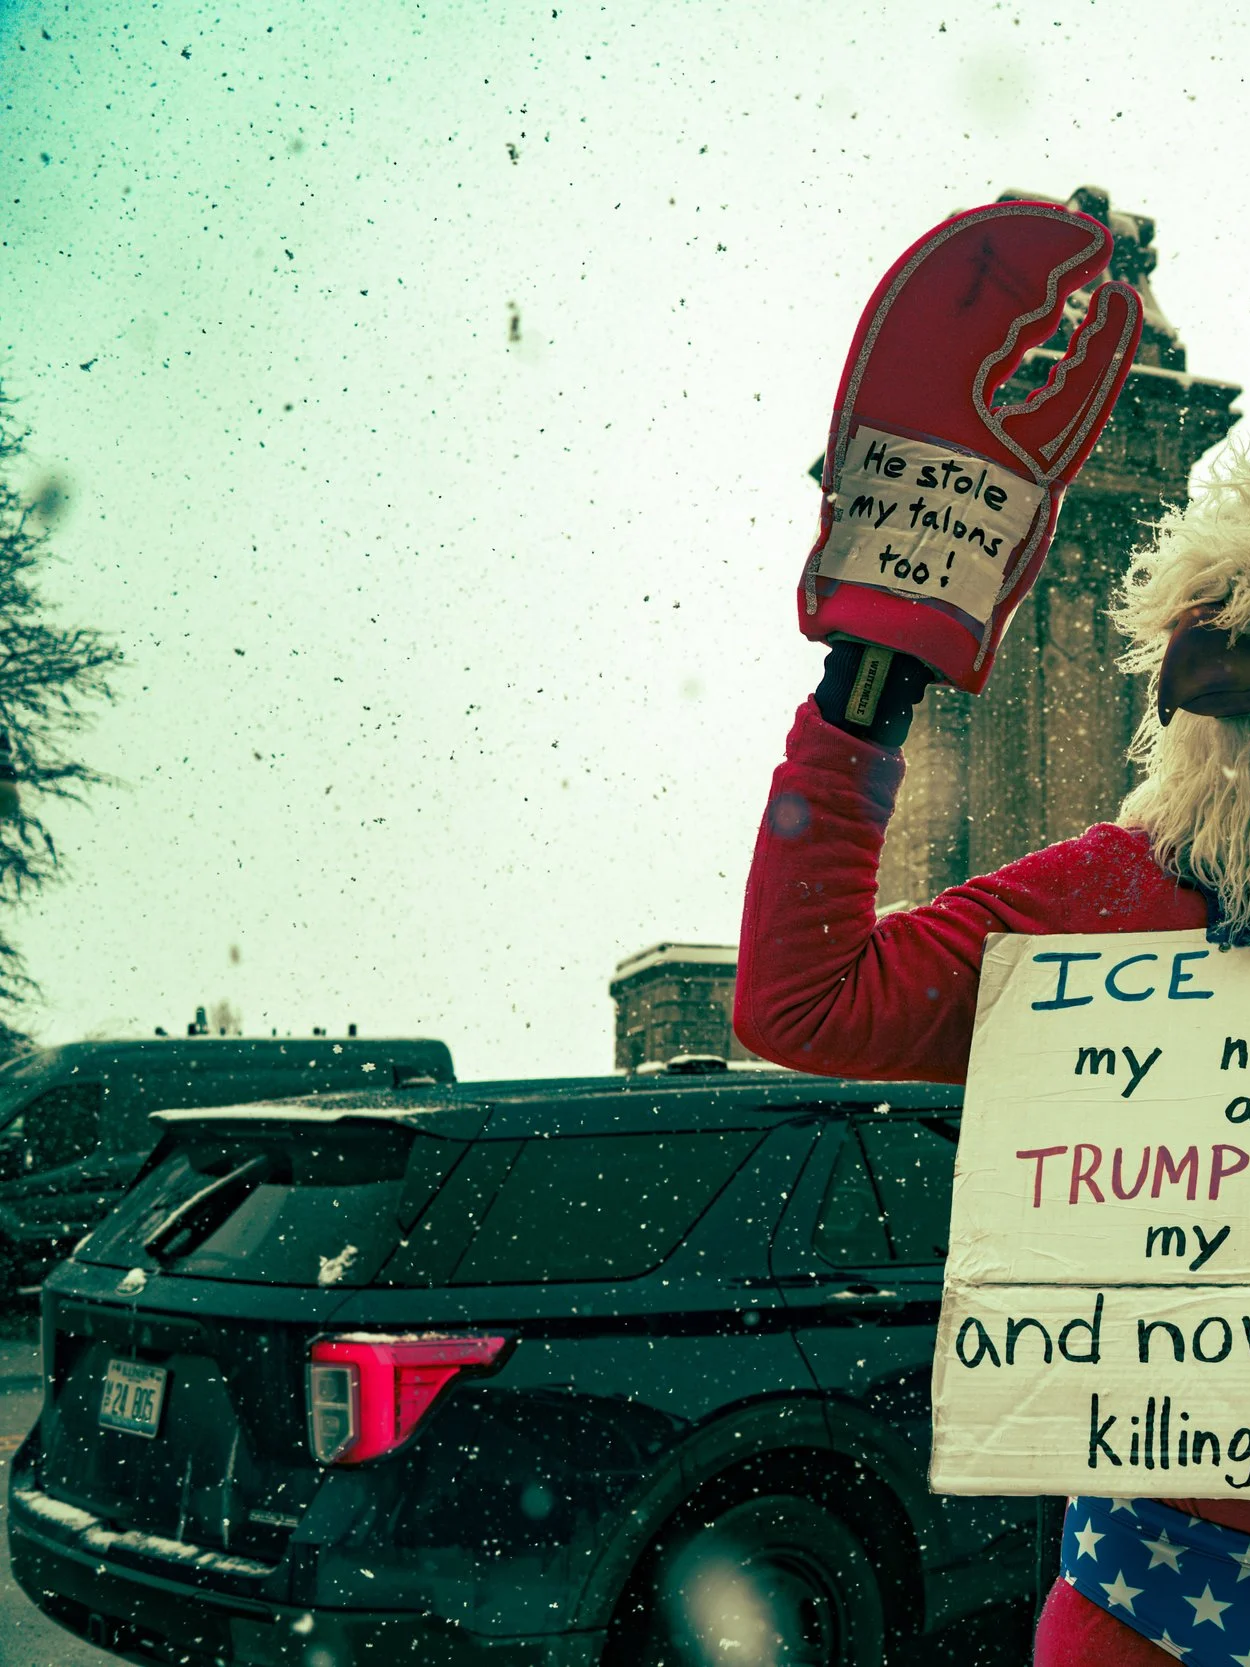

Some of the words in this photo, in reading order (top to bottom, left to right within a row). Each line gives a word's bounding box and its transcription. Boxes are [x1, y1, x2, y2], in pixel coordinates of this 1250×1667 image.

[864, 441, 907, 478] He
[916, 460, 1008, 512] stole
[849, 495, 898, 530] my
[909, 497, 1003, 558] talons
[879, 544, 956, 588] too!
[1031, 949, 1215, 1010] ICE
[1075, 1046, 1163, 1098] my
[1016, 1144, 1250, 1208] TRUMP
[1146, 1224, 1231, 1271] my
[956, 1293, 1105, 1369] and
